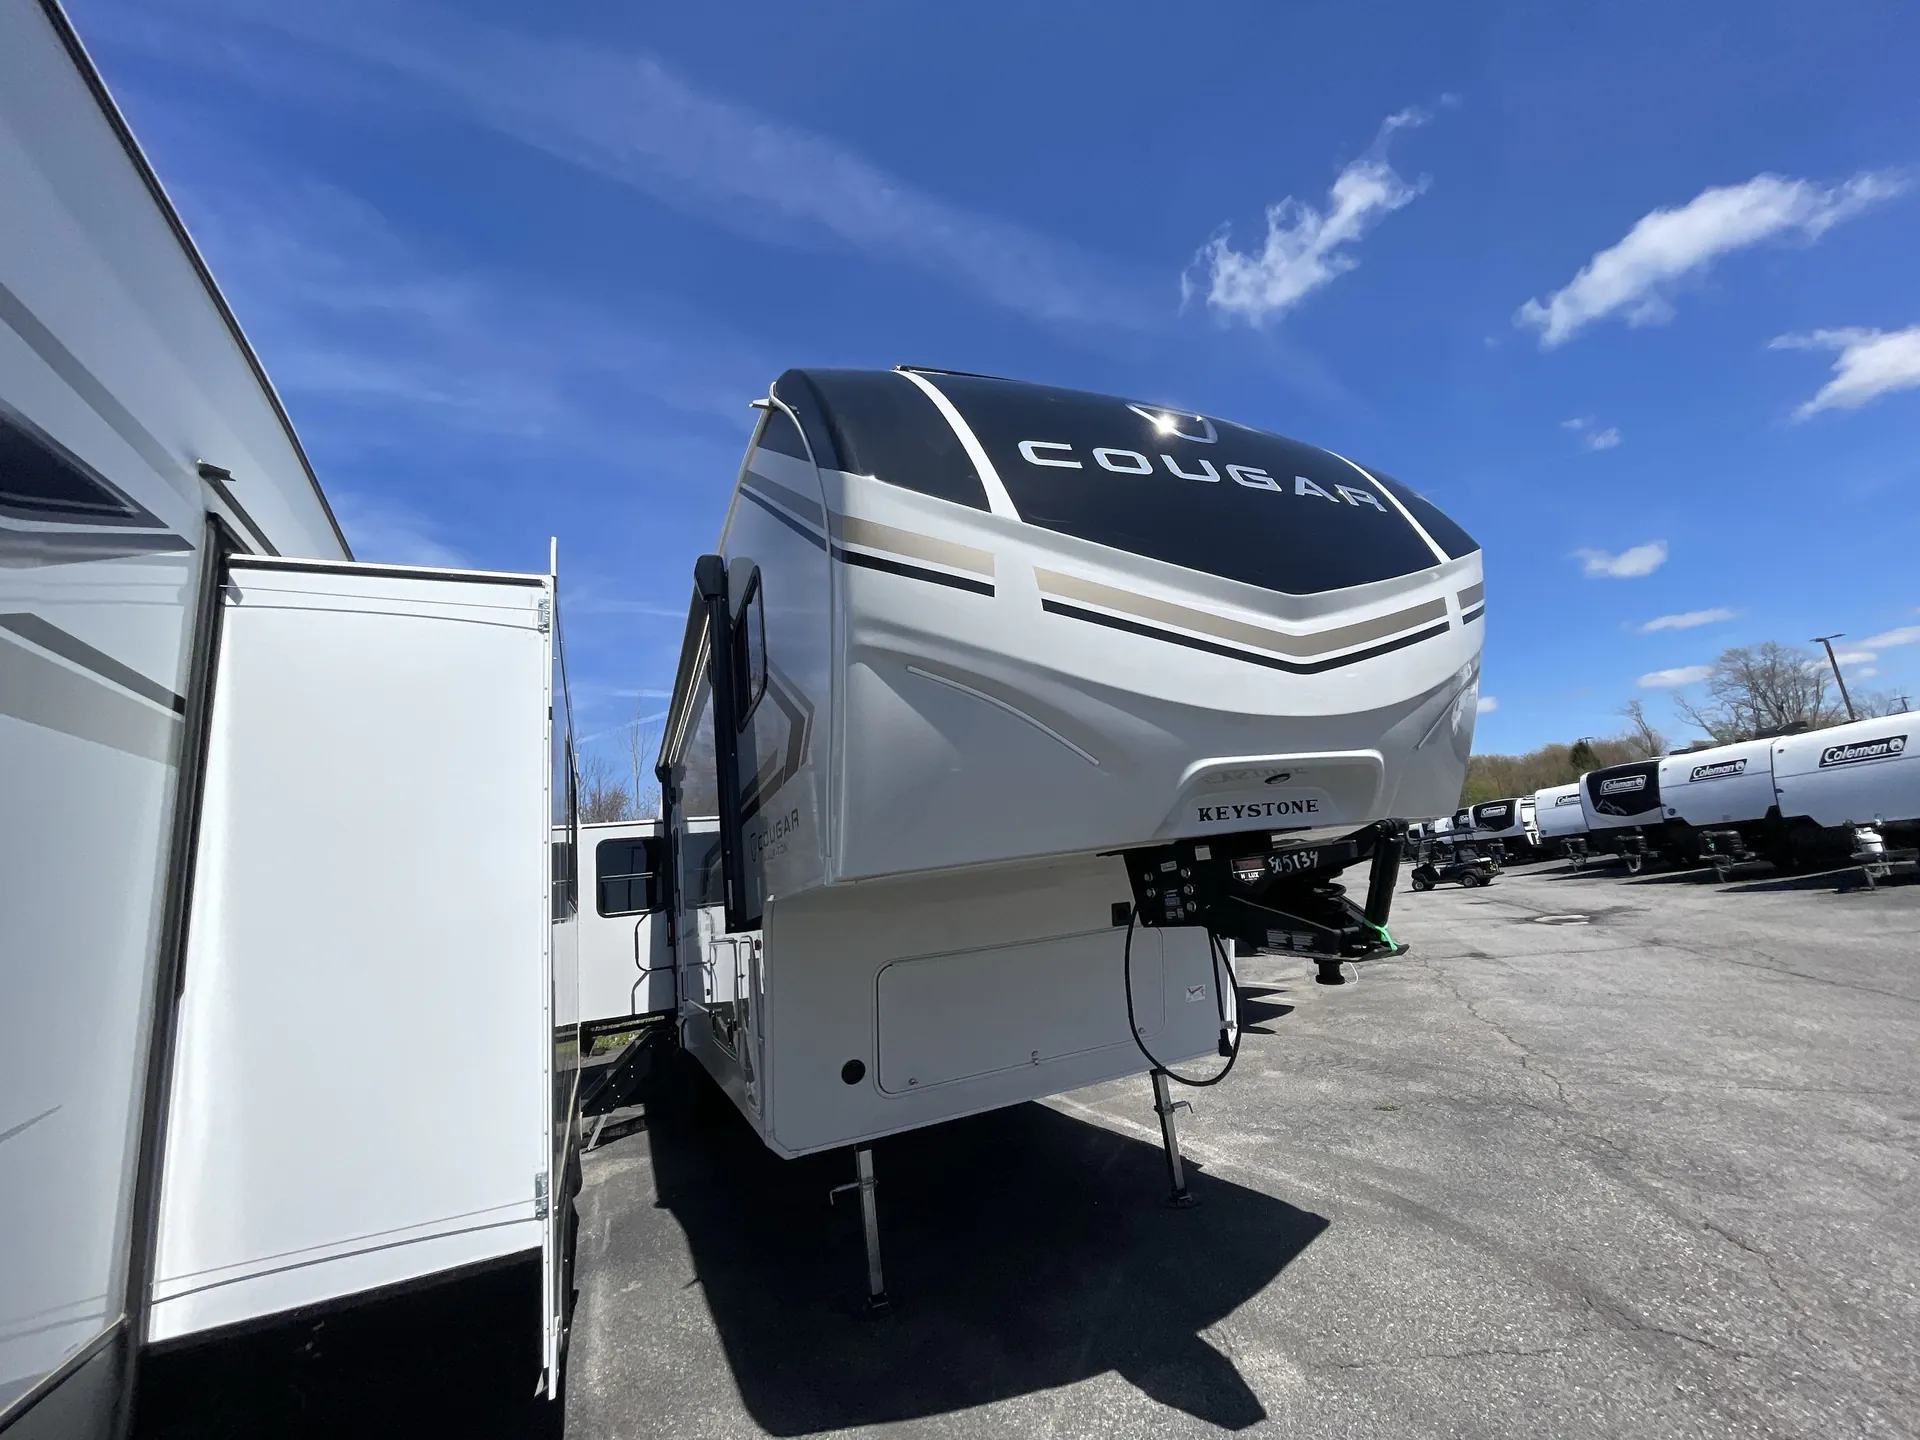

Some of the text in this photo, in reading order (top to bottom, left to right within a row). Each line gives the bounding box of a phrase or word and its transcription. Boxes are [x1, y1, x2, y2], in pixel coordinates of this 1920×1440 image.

[1018, 440, 1388, 512] COUGAR
[1825, 743, 1887, 763] Coleman
[1693, 763, 1733, 778] Coleman
[1604, 780, 1636, 791] Coleman
[1198, 799, 1319, 822] KEYSTONE
[758, 808, 799, 851] COUGAR
